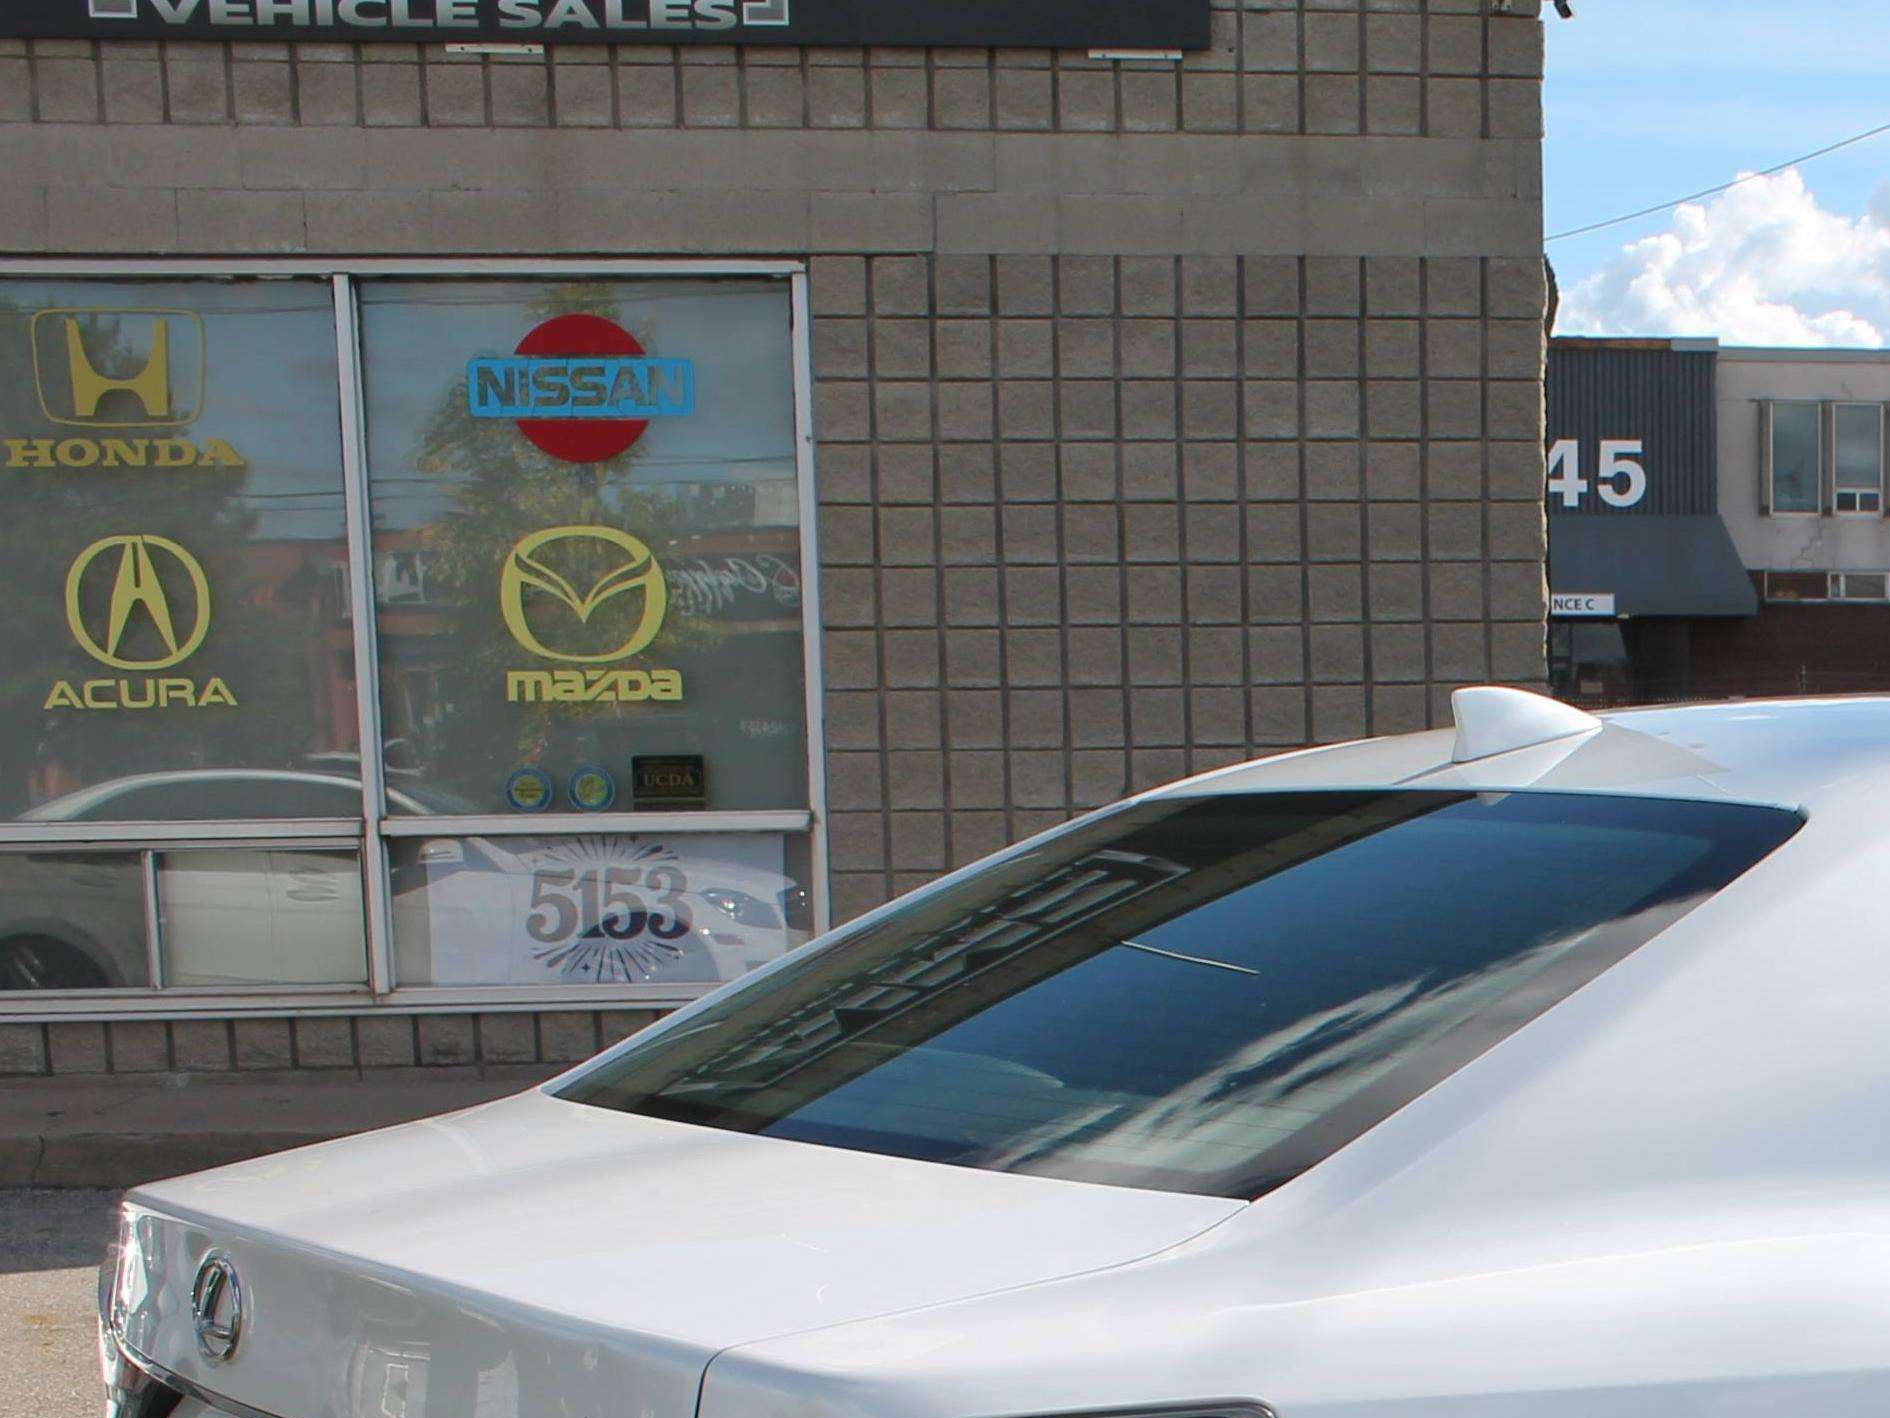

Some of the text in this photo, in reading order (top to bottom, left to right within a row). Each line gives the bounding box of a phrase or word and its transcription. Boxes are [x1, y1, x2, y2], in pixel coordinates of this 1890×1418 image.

[153, 0, 737, 30] VEHICLE SALES
[477, 366, 685, 407] NISSAN
[4, 438, 246, 467] HONDA
[1548, 439, 1647, 507] 45
[43, 677, 238, 709] ACURA
[643, 772, 695, 787] UCDA
[525, 865, 693, 943] 5153
